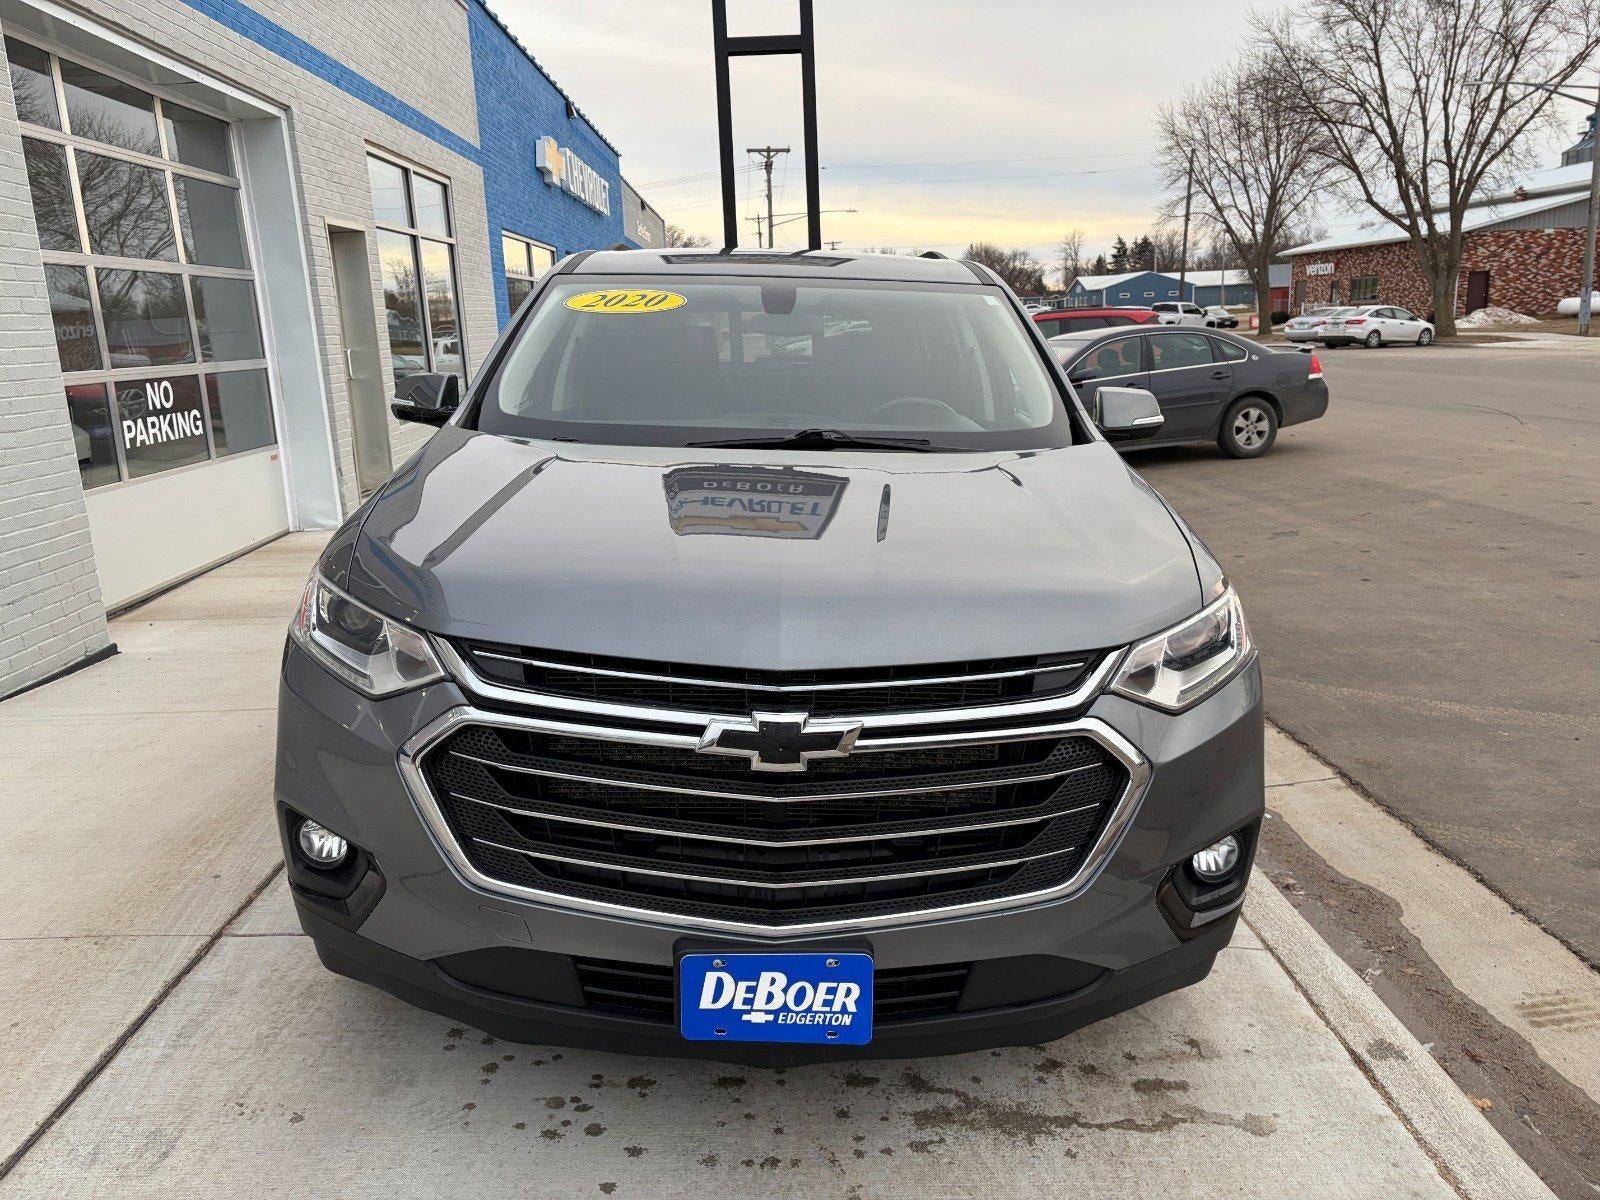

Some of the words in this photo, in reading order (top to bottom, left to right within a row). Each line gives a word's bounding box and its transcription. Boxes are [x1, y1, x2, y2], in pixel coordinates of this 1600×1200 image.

[1306, 262, 1334, 276] verizon
[581, 293, 670, 308] 2020
[145, 380, 174, 411] NO
[122, 409, 204, 449] PARKING
[777, 1012, 853, 1026] EDGERTON
